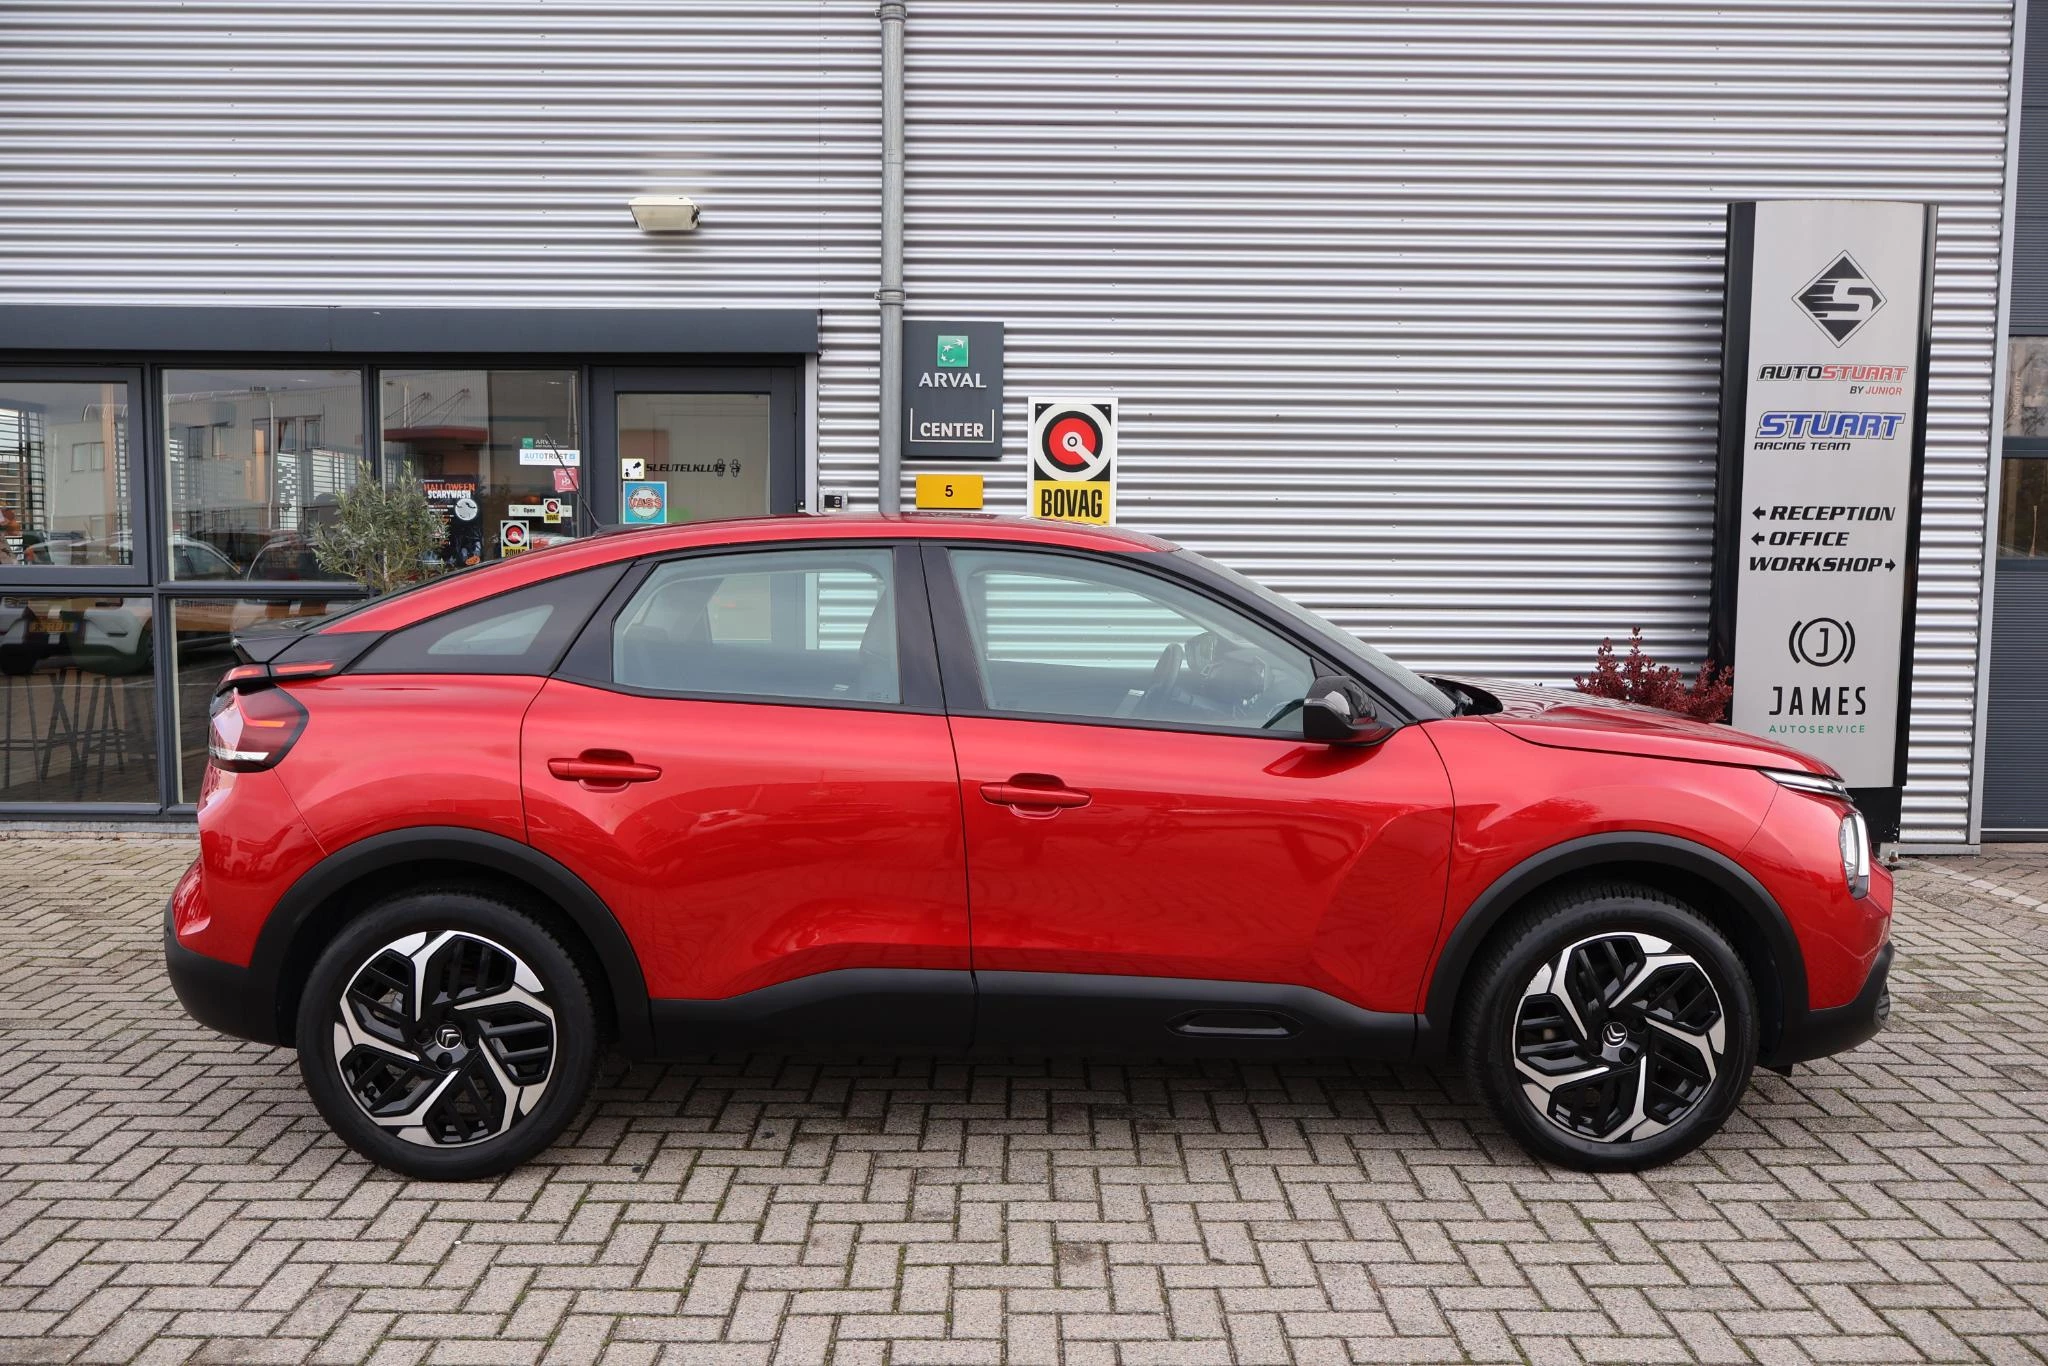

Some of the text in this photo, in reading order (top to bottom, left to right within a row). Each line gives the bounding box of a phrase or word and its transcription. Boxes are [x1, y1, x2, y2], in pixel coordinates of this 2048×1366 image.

[918, 372, 987, 388] ARVAL
[1757, 364, 1909, 381] AUTOSTUART
[1849, 386, 1903, 396] BY JUNIOR
[920, 422, 984, 438] CENTER
[1755, 411, 1906, 440] STUART
[1753, 442, 1851, 451] RACING TEAM
[524, 452, 569, 460] AUTOTRUST
[423, 482, 476, 491] HALLOWEEN
[944, 484, 954, 498] 5
[427, 490, 471, 499] SCARYWASH
[1040, 488, 1103, 518] BOVAG
[1769, 505, 1896, 521] RECEPTION
[1768, 531, 1850, 546] OFFICE
[1749, 556, 1883, 572] WORKSHOP
[1768, 686, 1866, 716] JAMES
[1768, 724, 1866, 734] AUTOSERVICE
